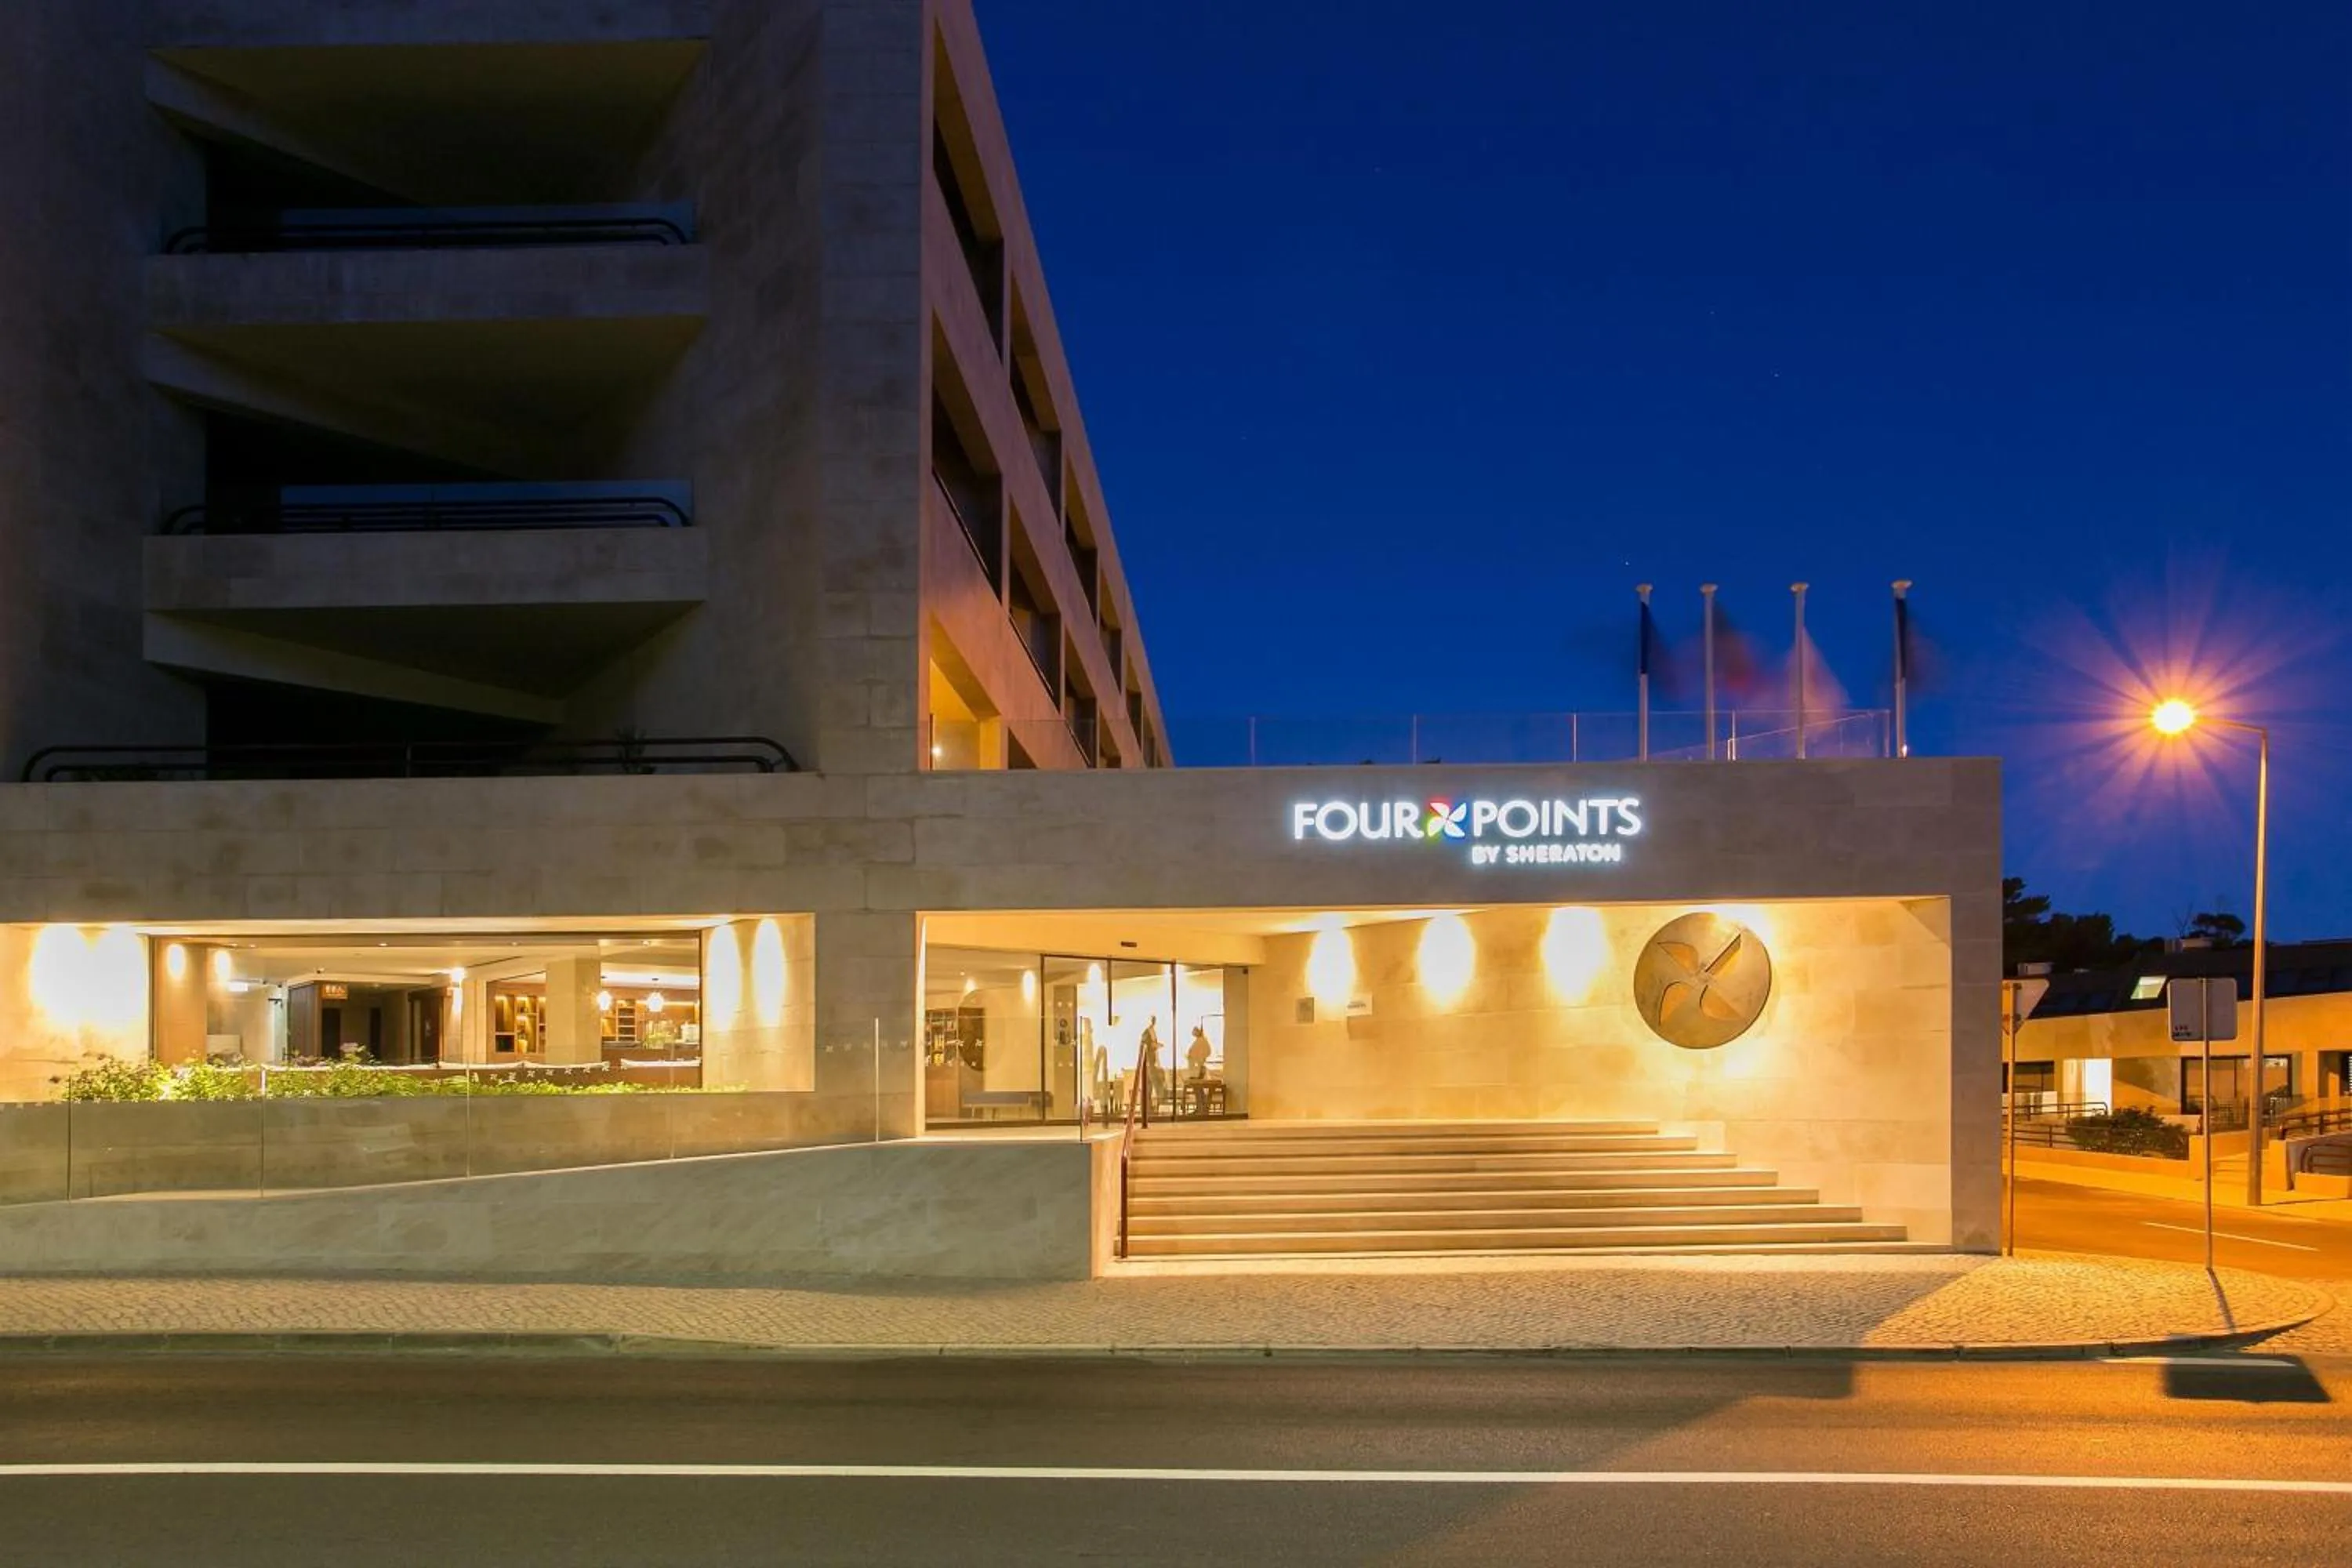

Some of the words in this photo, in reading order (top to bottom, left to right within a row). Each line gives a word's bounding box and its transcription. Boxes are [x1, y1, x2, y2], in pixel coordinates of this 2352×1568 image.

[1293, 800, 1424, 840] FOUR
[1472, 797, 1642, 837] POINTS
[1472, 846, 1501, 864] BY
[1505, 843, 1621, 863] SHERATON
